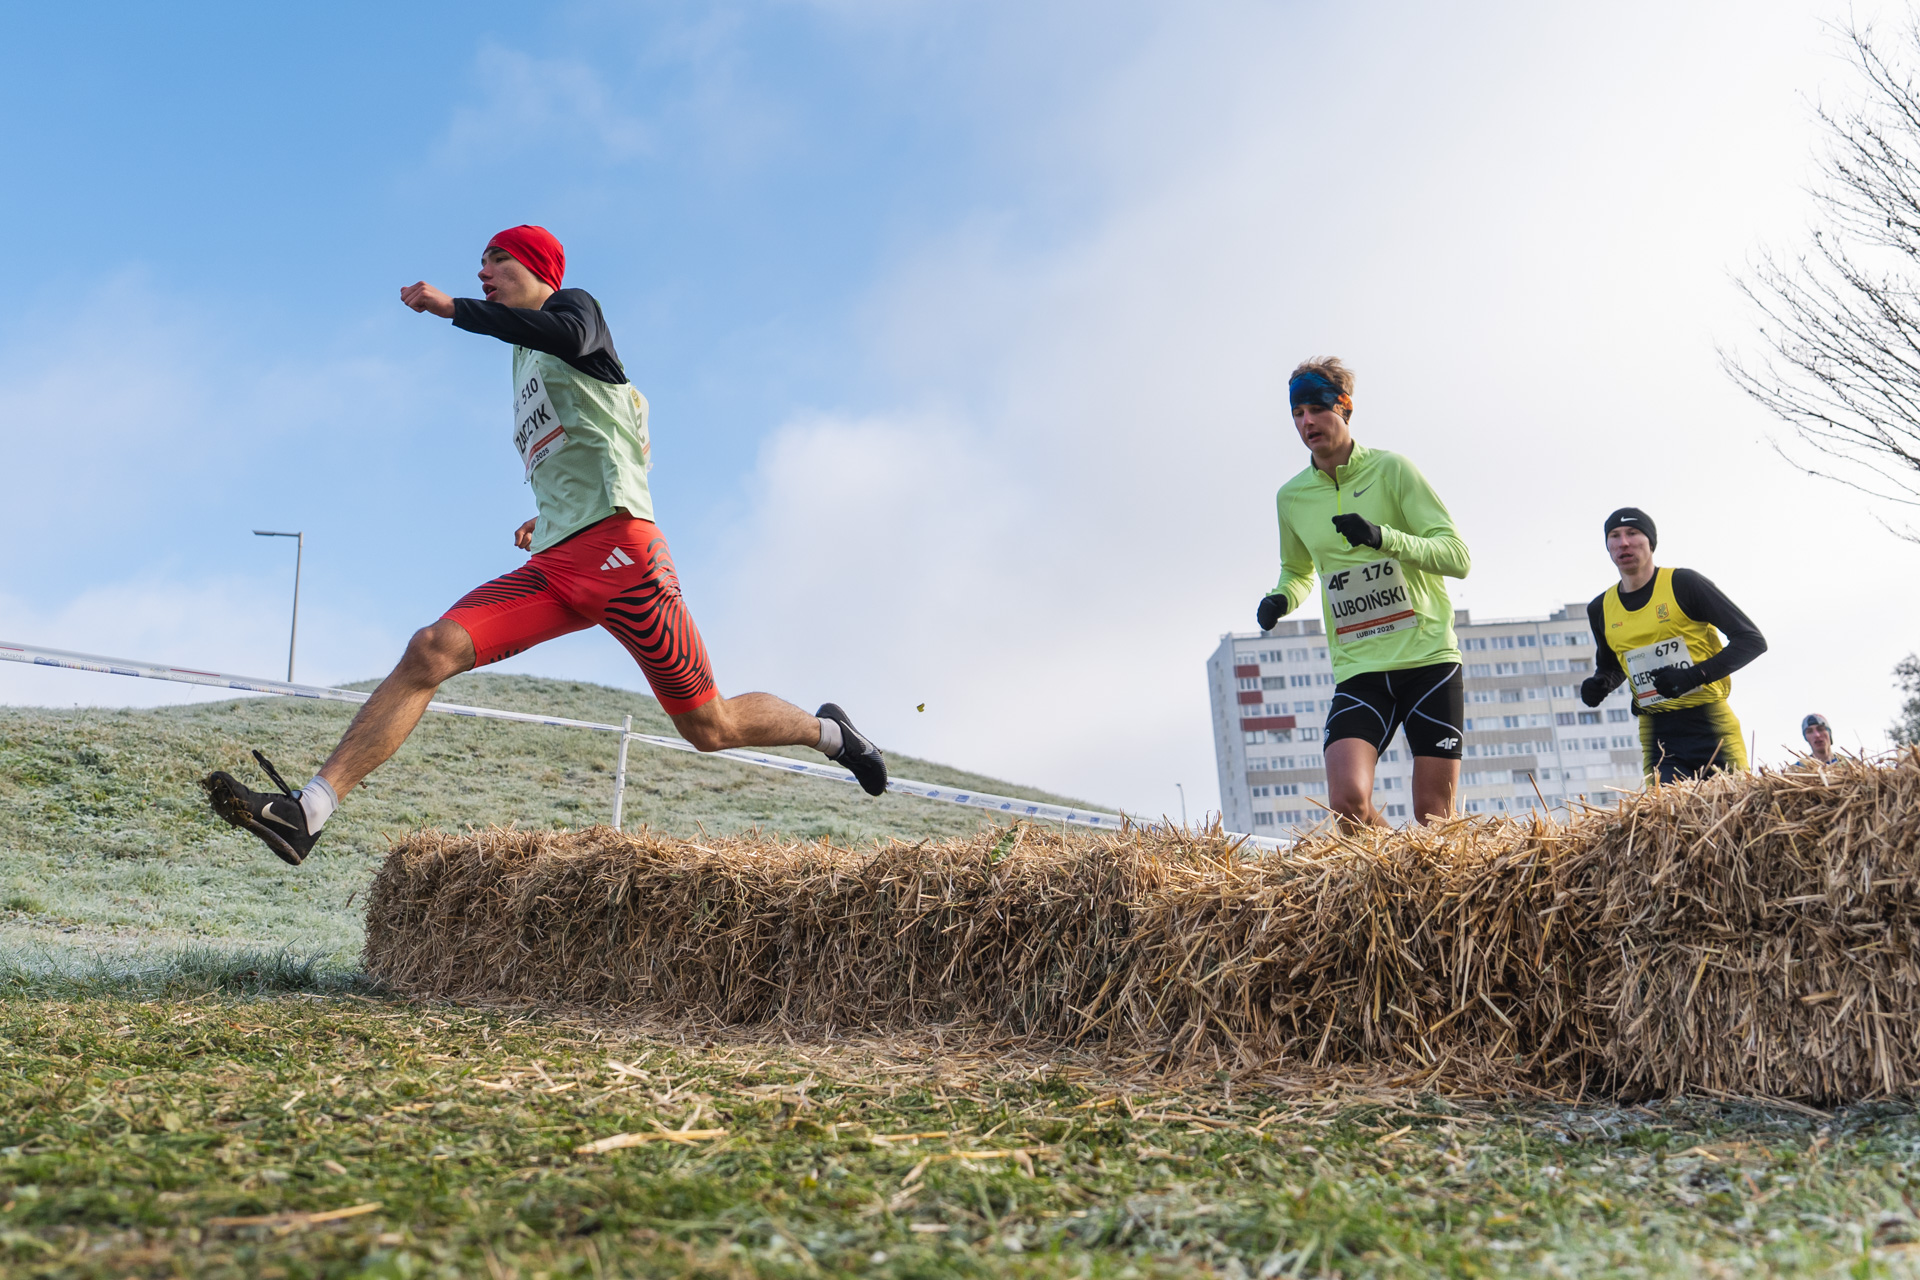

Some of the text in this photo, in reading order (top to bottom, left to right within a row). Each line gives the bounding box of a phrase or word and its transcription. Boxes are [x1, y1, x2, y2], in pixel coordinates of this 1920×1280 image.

[521, 377, 539, 405] 510
[535, 447, 550, 461] 2025
[1361, 561, 1394, 582] 176
[1328, 571, 1351, 591] 4F
[1331, 585, 1407, 619] LUBOIŃSKI
[1356, 624, 1395, 639] LUBIN 2025
[1655, 641, 1679, 657] 679
[1435, 737, 1459, 750] 4F
